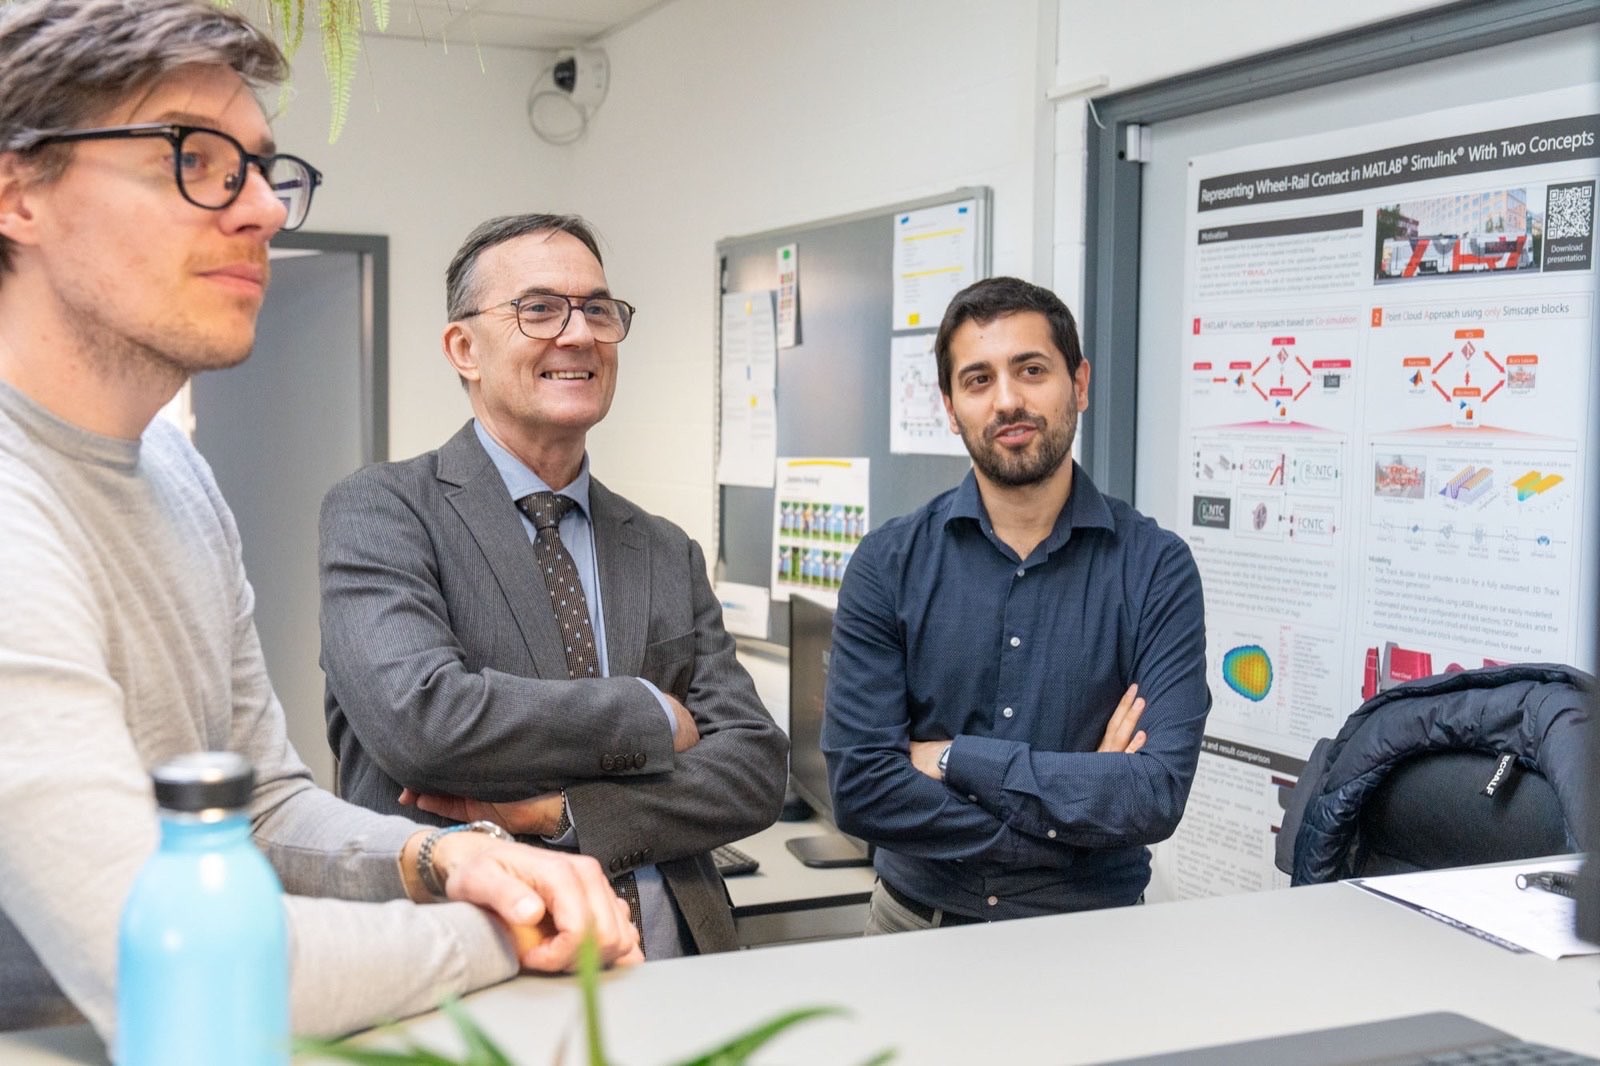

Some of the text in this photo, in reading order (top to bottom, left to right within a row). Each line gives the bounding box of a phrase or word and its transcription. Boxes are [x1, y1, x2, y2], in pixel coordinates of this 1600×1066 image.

[1201, 183, 1254, 205] Representing
[1256, 173, 1309, 194] Wheel-Rail
[1311, 168, 1349, 187] Contact
[1351, 166, 1360, 181] in
[1468, 143, 1497, 162] With
[1501, 140, 1526, 157] Two
[1529, 131, 1595, 152] Concepts
[1551, 243, 1583, 253] Download
[1547, 254, 1587, 264] presentation
[1385, 311, 1401, 321] Point
[1403, 310, 1422, 321] Cloud
[1424, 308, 1460, 321] Approach
[1461, 308, 1482, 320] using
[1484, 307, 1501, 318] only
[1503, 304, 1540, 317] Simscape
[1541, 302, 1569, 314] blocks
[1256, 318, 1285, 330] Approach
[1286, 317, 1304, 327] based
[1306, 318, 1313, 326] on
[1500, 583, 1529, 593] automated
[1544, 586, 1559, 596] Track
[1482, 627, 1519, 638] representation
[1515, 620, 1532, 630] blocks
[1534, 624, 1546, 632] and
[1548, 625, 1558, 633] the
[1207, 742, 1219, 752] and
[1219, 744, 1236, 756] result
[1236, 748, 1270, 764] comparison
[1486, 755, 1511, 796] ECOALF
